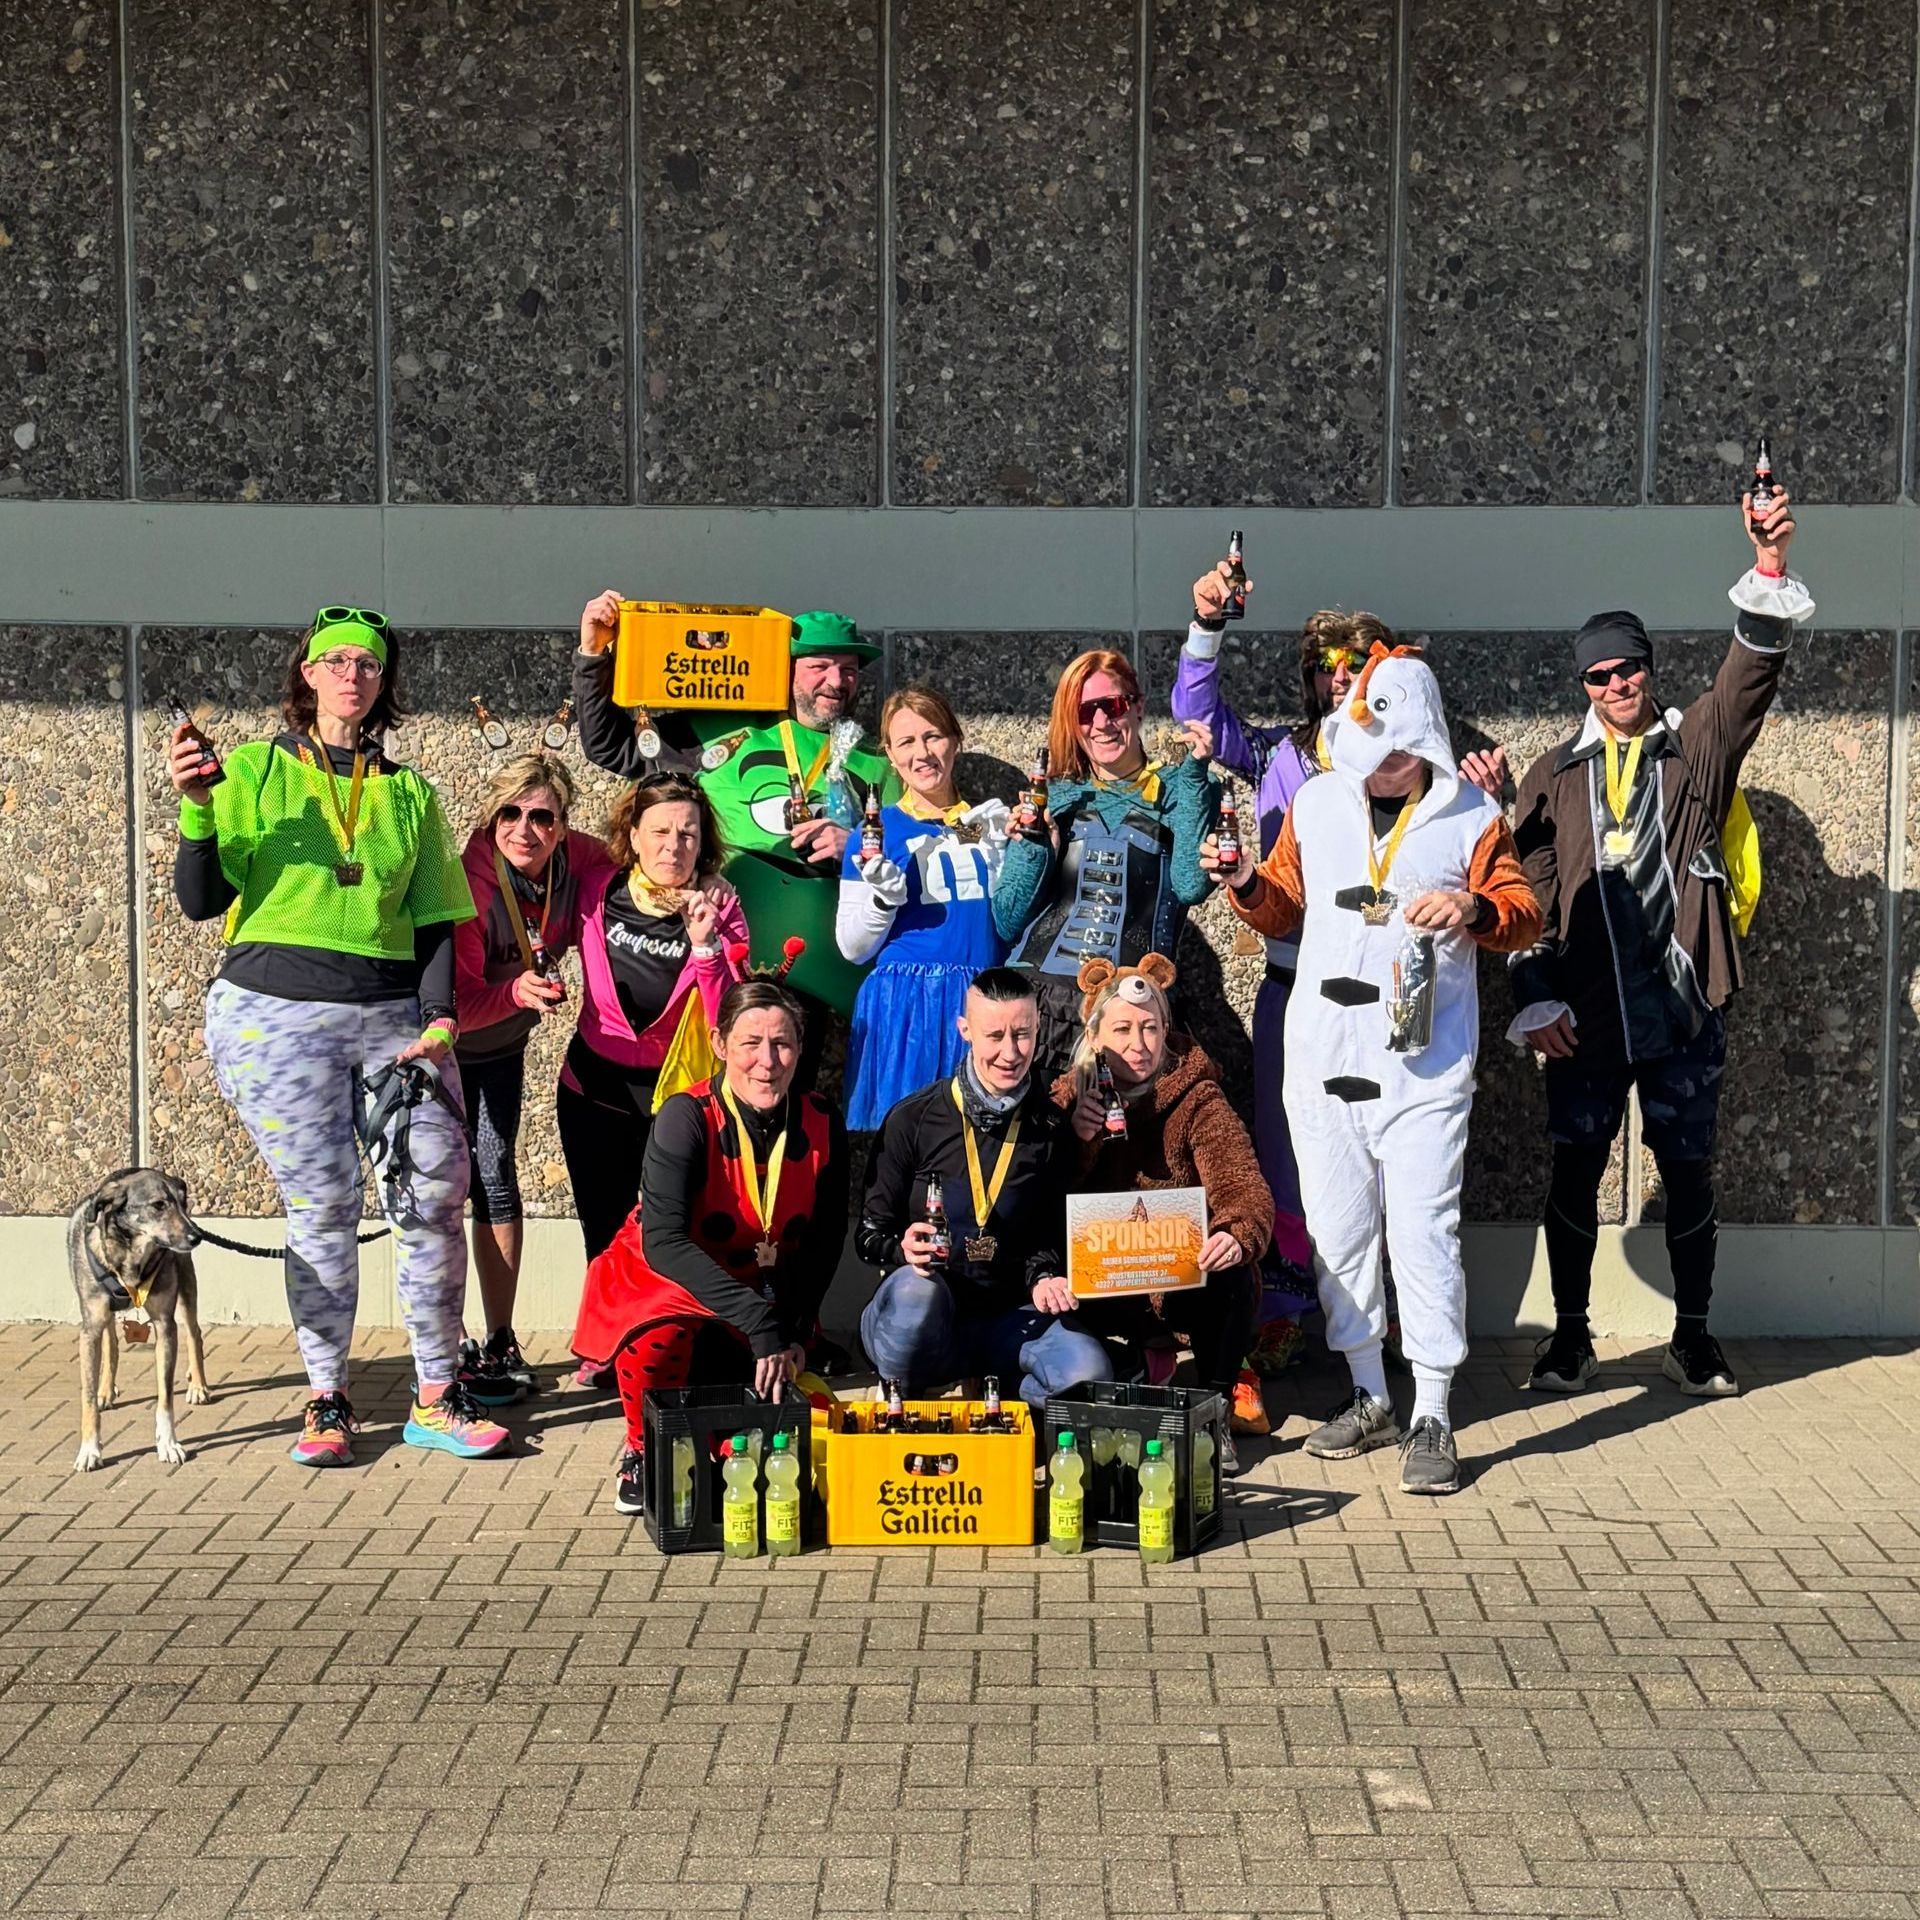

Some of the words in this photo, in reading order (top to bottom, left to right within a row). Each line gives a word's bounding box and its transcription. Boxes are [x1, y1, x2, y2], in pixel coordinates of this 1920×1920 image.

[662, 651, 750, 676] Estrella
[665, 675, 745, 701] Galicia
[606, 921, 688, 958] Laufuschi
[1086, 1218, 1190, 1253] SPONSOR
[876, 1479, 983, 1507] Estrella
[880, 1507, 978, 1536] Galicia
